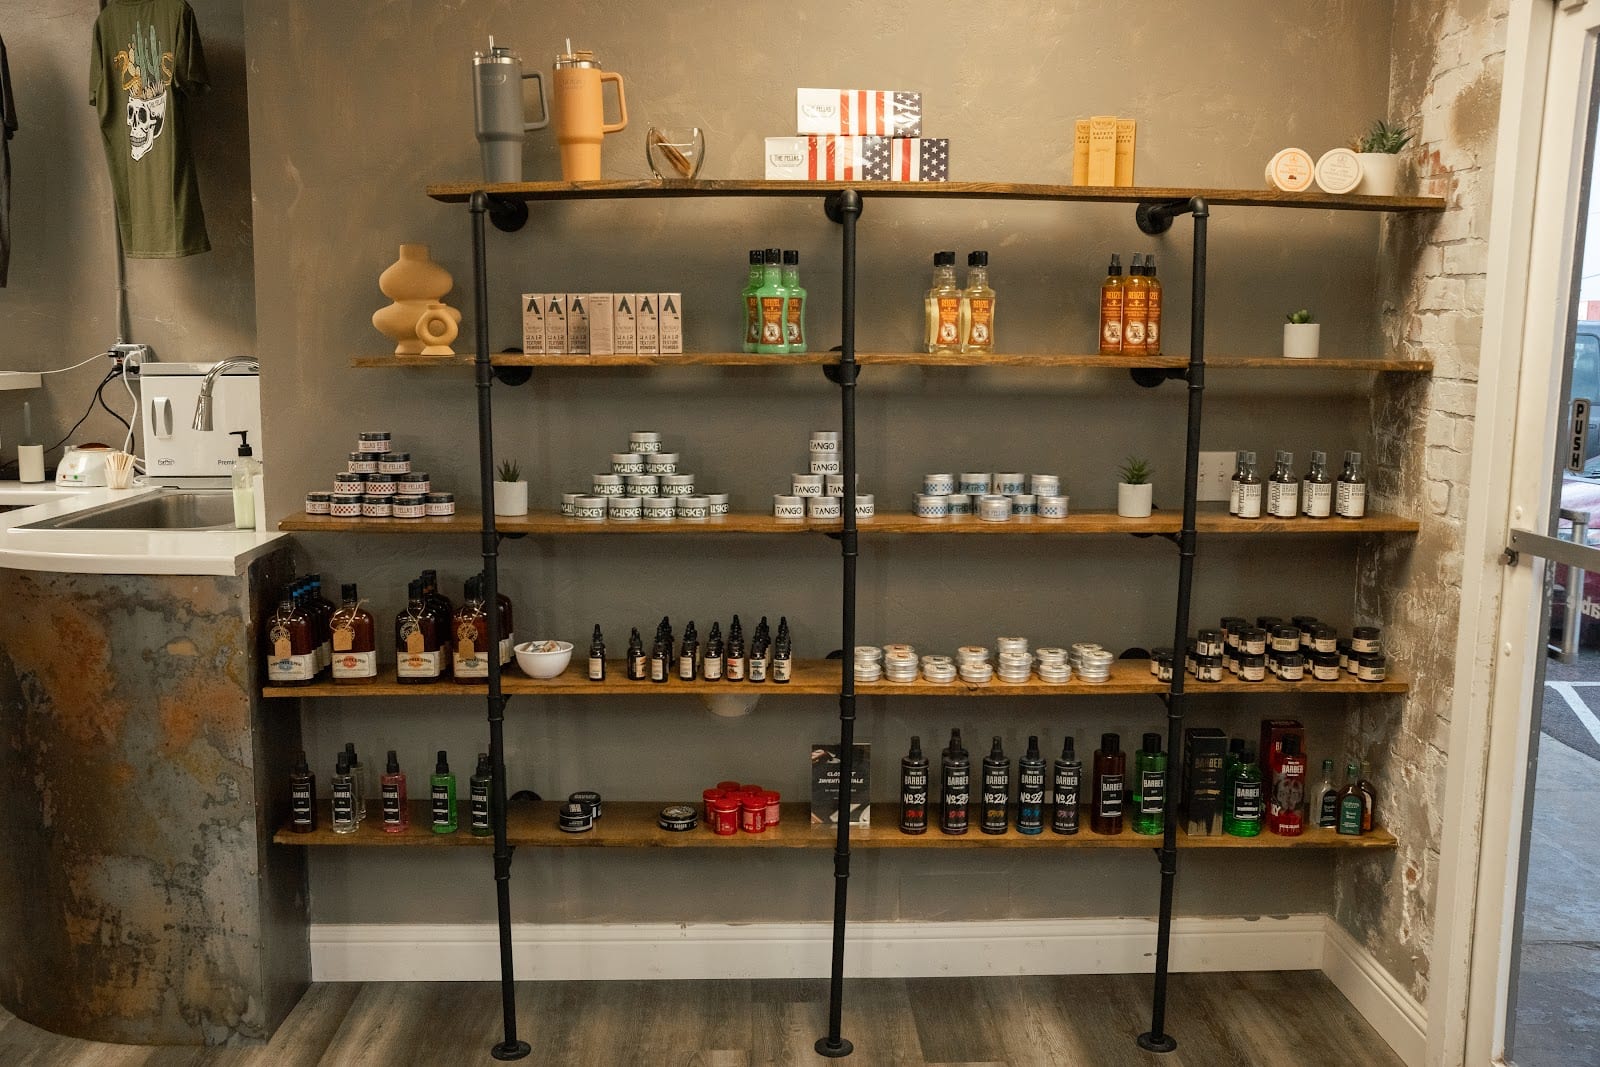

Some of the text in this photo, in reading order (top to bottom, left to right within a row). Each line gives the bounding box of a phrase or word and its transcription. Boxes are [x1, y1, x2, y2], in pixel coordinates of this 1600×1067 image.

[1572, 404, 1584, 467] PUSH
[810, 442, 834, 450] TANGO
[812, 463, 838, 472] TANGO
[794, 486, 820, 494] TANGO
[829, 485, 844, 494] TAN
[776, 506, 802, 515] TANGO
[814, 506, 840, 515] TANGO
[905, 776, 926, 785] BARBER
[986, 776, 1008, 785] BARBER
[1022, 774, 1043, 784] BARBER
[1056, 776, 1078, 785] BARBER
